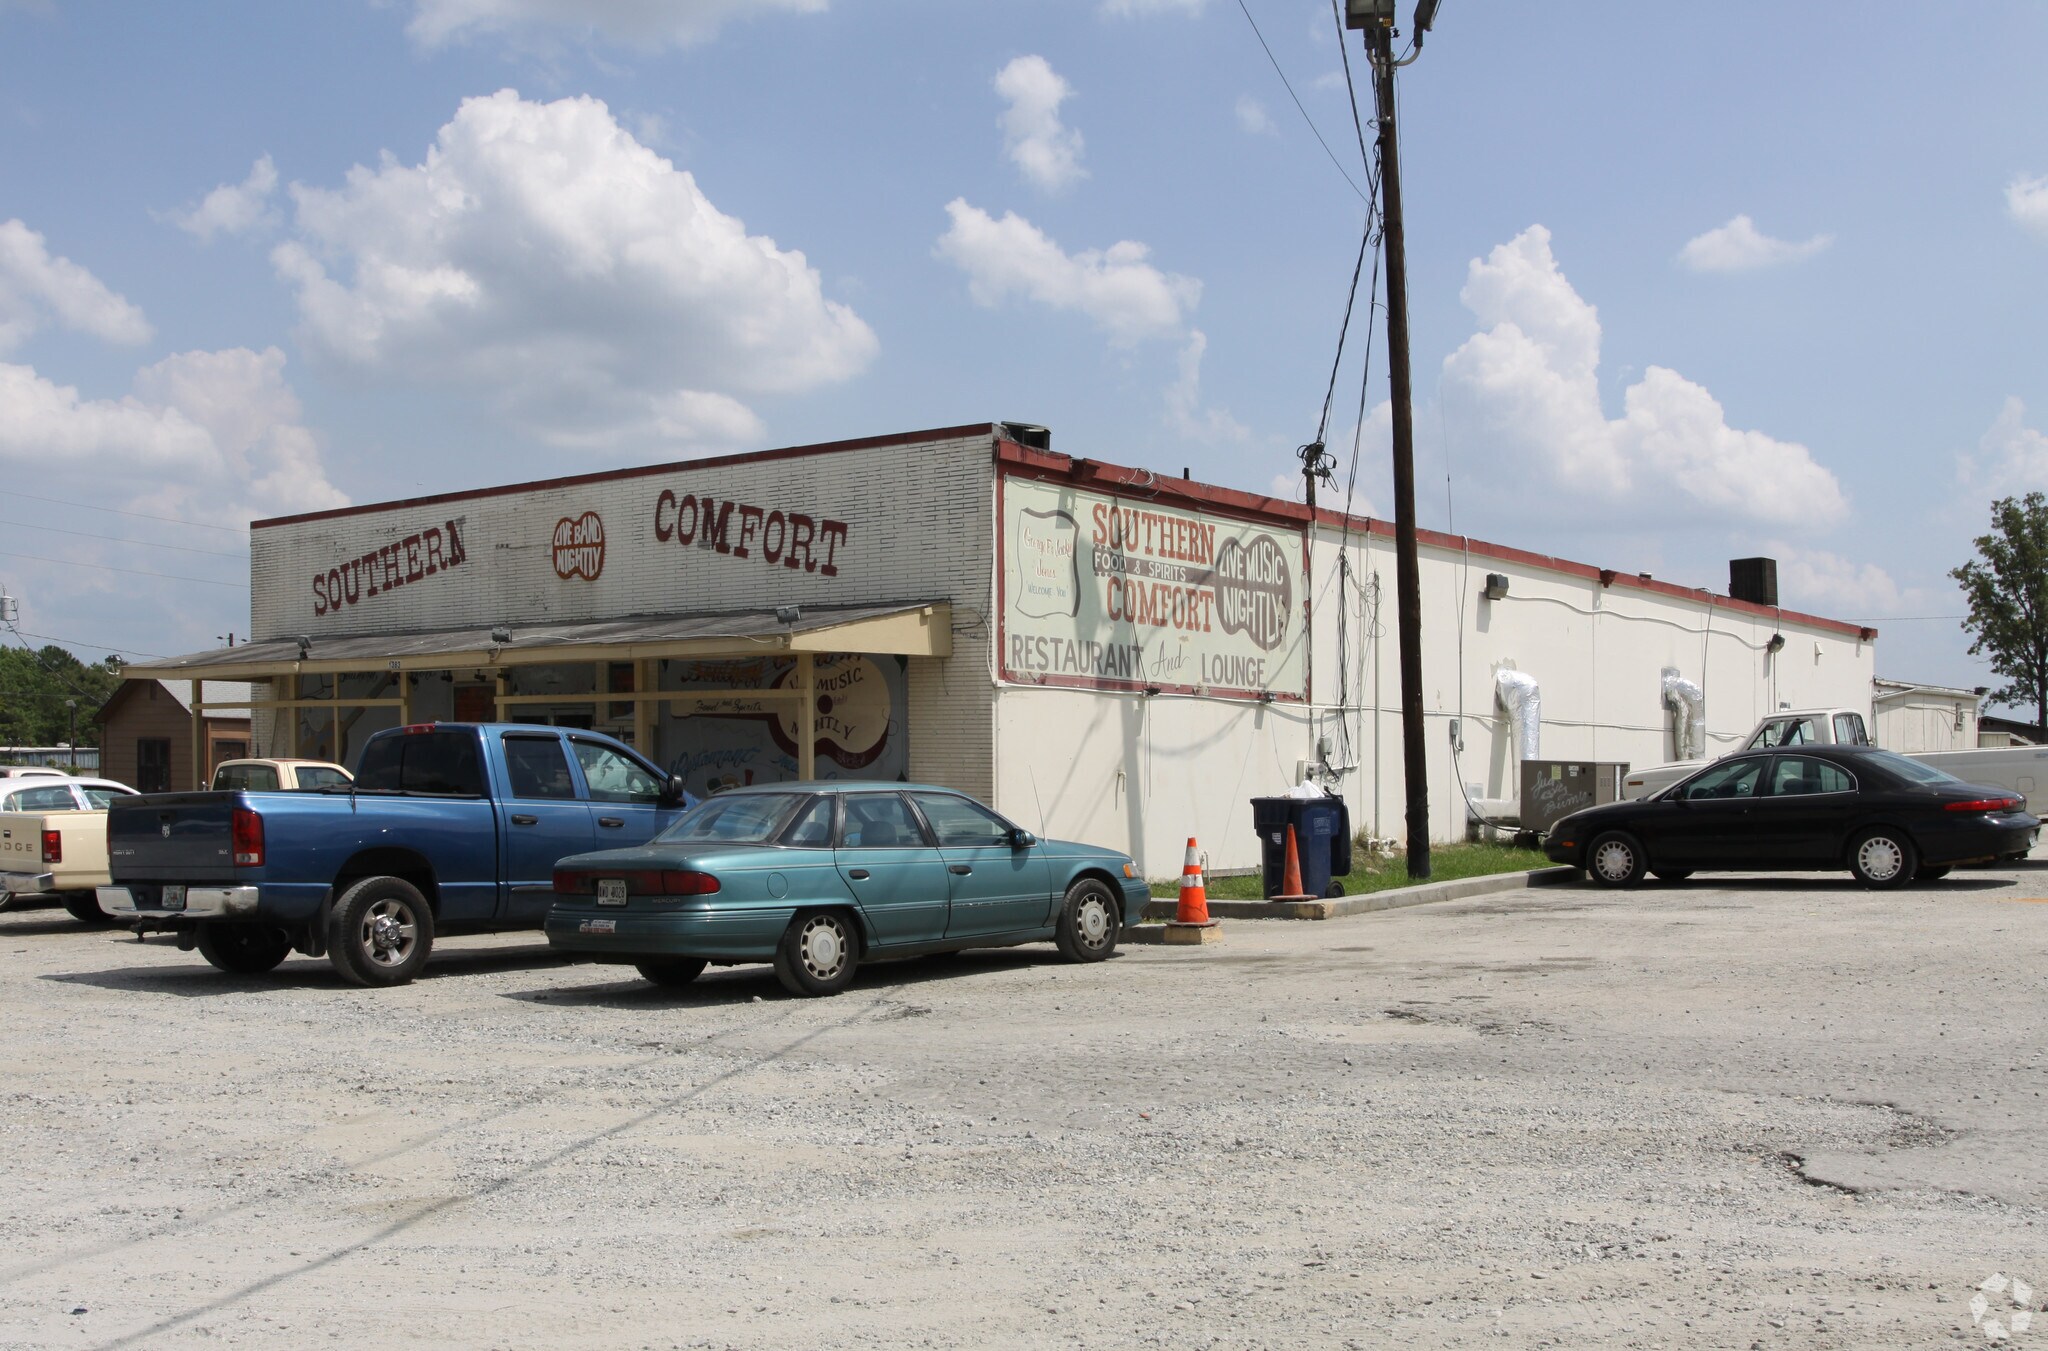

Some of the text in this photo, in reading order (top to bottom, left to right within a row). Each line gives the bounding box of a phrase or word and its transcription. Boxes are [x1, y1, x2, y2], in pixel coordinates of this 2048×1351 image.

[554, 515, 602, 546] LIVE BAND
[655, 489, 848, 577] COMFORT
[1092, 503, 1216, 566] SOUTHERN
[313, 518, 466, 616] SOUTHERN
[556, 546, 602, 577] NIGHTLY
[1094, 551, 1186, 581] FOOD & SPIRITS
[1219, 541, 1284, 585] LIVE MUSIC
[1107, 576, 1214, 633] COMFORT
[1223, 586, 1283, 643] NIGHTLY
[816, 668, 864, 691] MUSIC
[1012, 634, 1266, 688] RESTAURANT And LOUNGE
